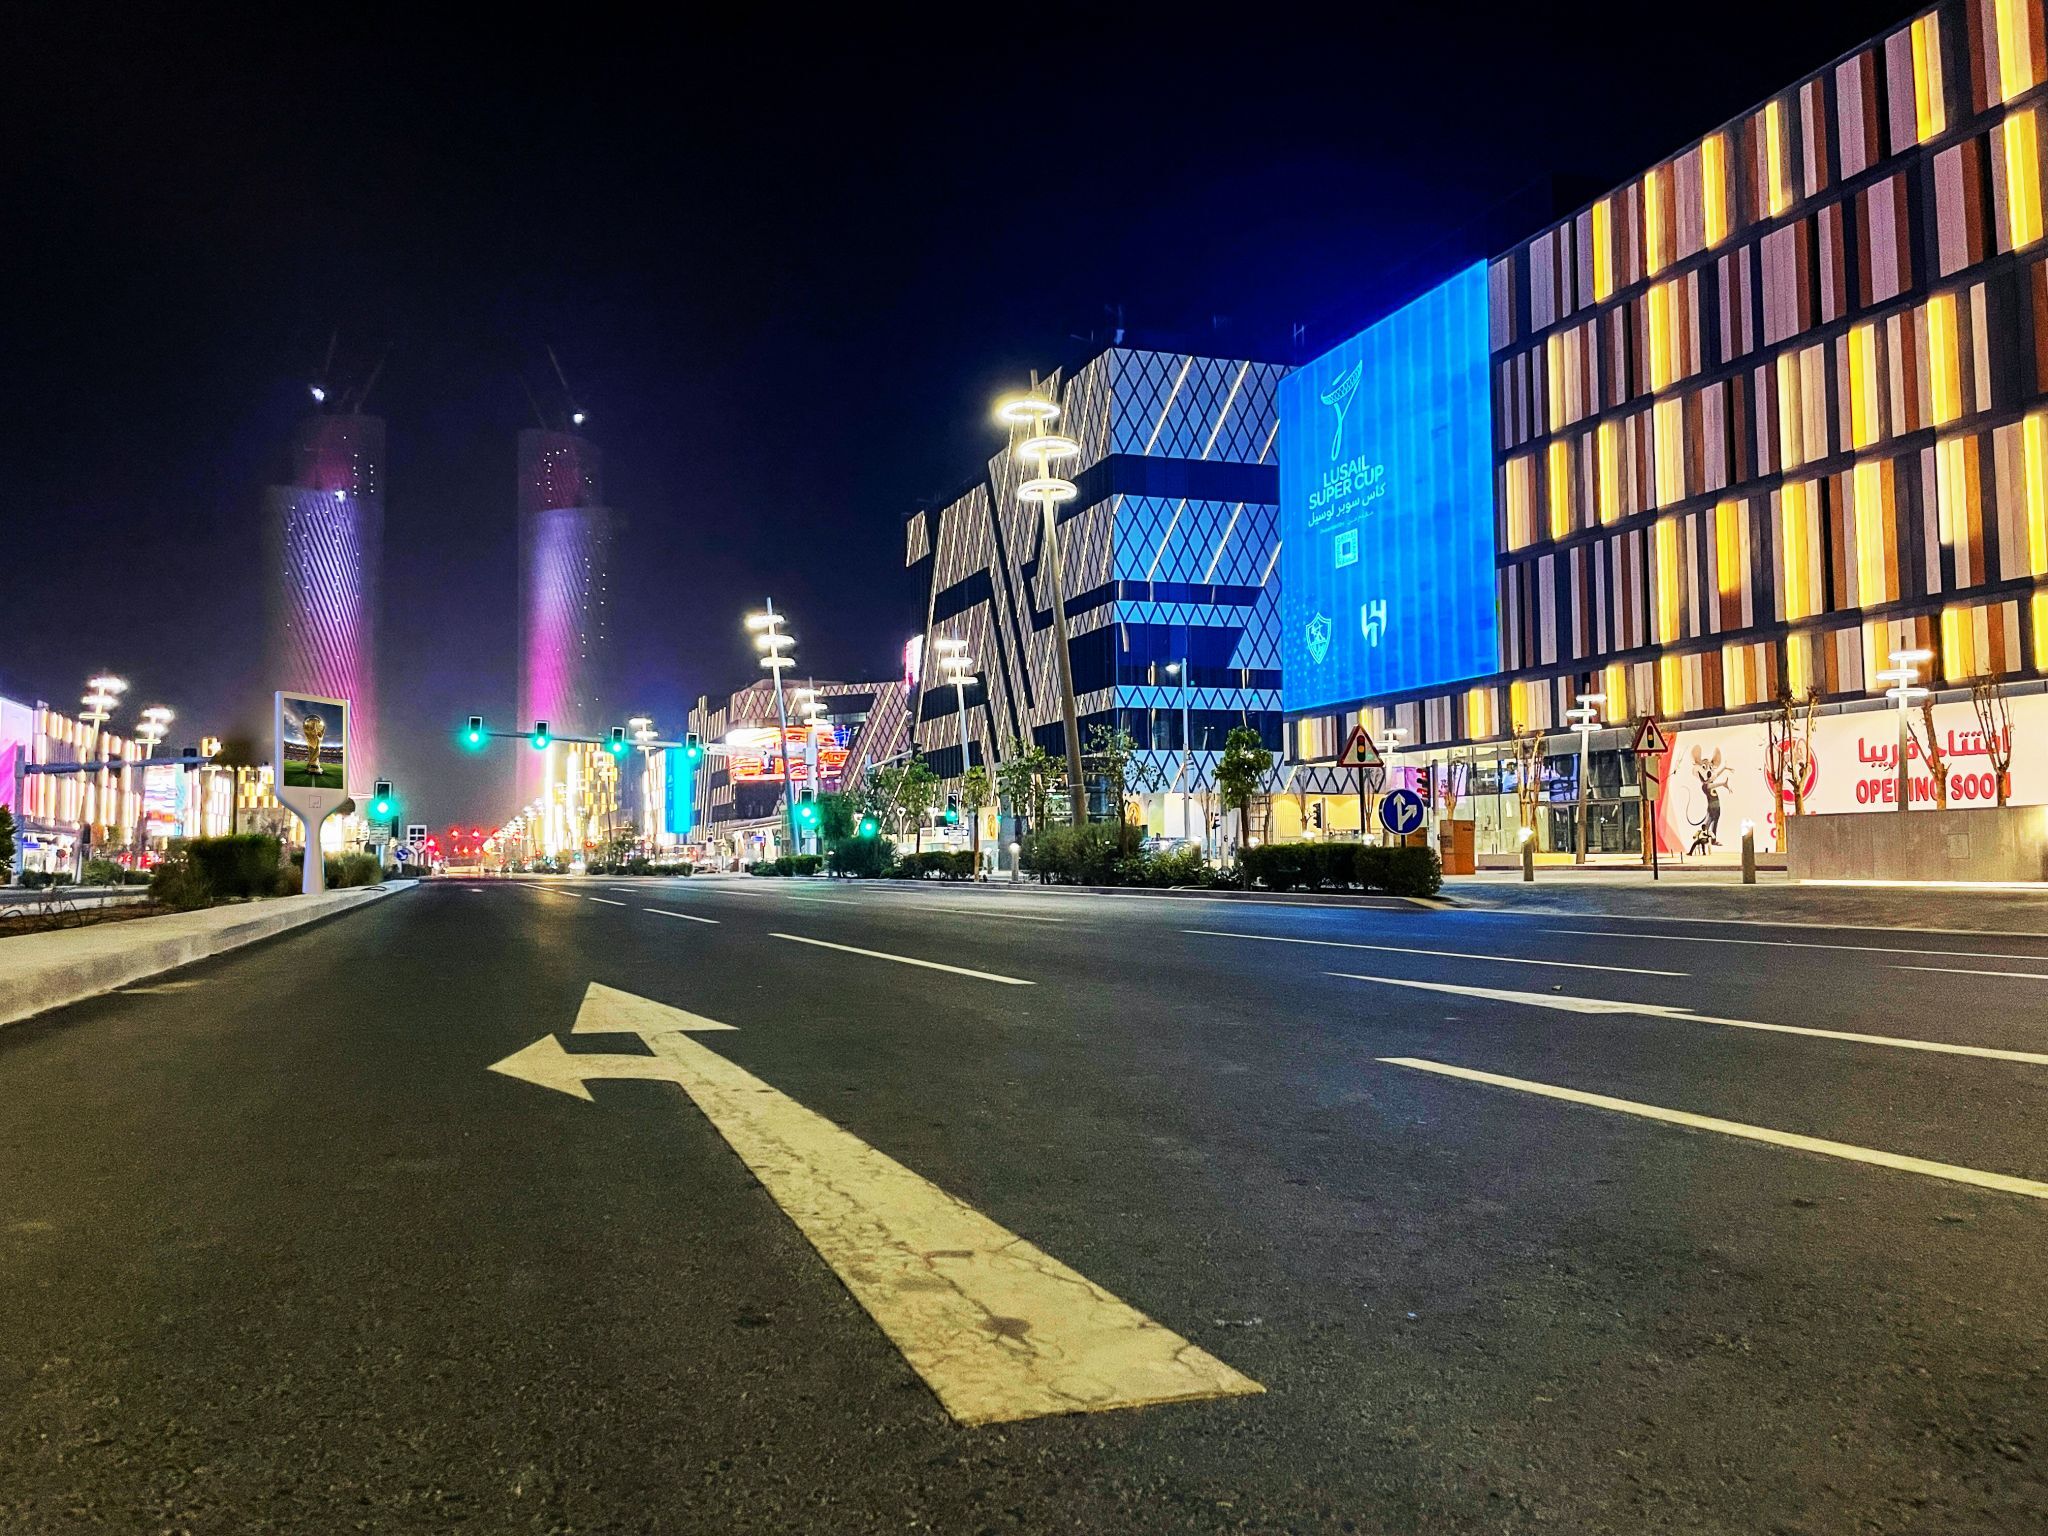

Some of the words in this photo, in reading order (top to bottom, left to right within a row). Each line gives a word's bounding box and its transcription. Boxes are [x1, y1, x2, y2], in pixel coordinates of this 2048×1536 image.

[1323, 455, 1370, 487] LUSAIL
[1309, 478, 1352, 510] SUPER
[1354, 464, 1384, 489] CUP
[1308, 503, 1334, 527] لوسيل
[1336, 497, 1360, 517] سوبر
